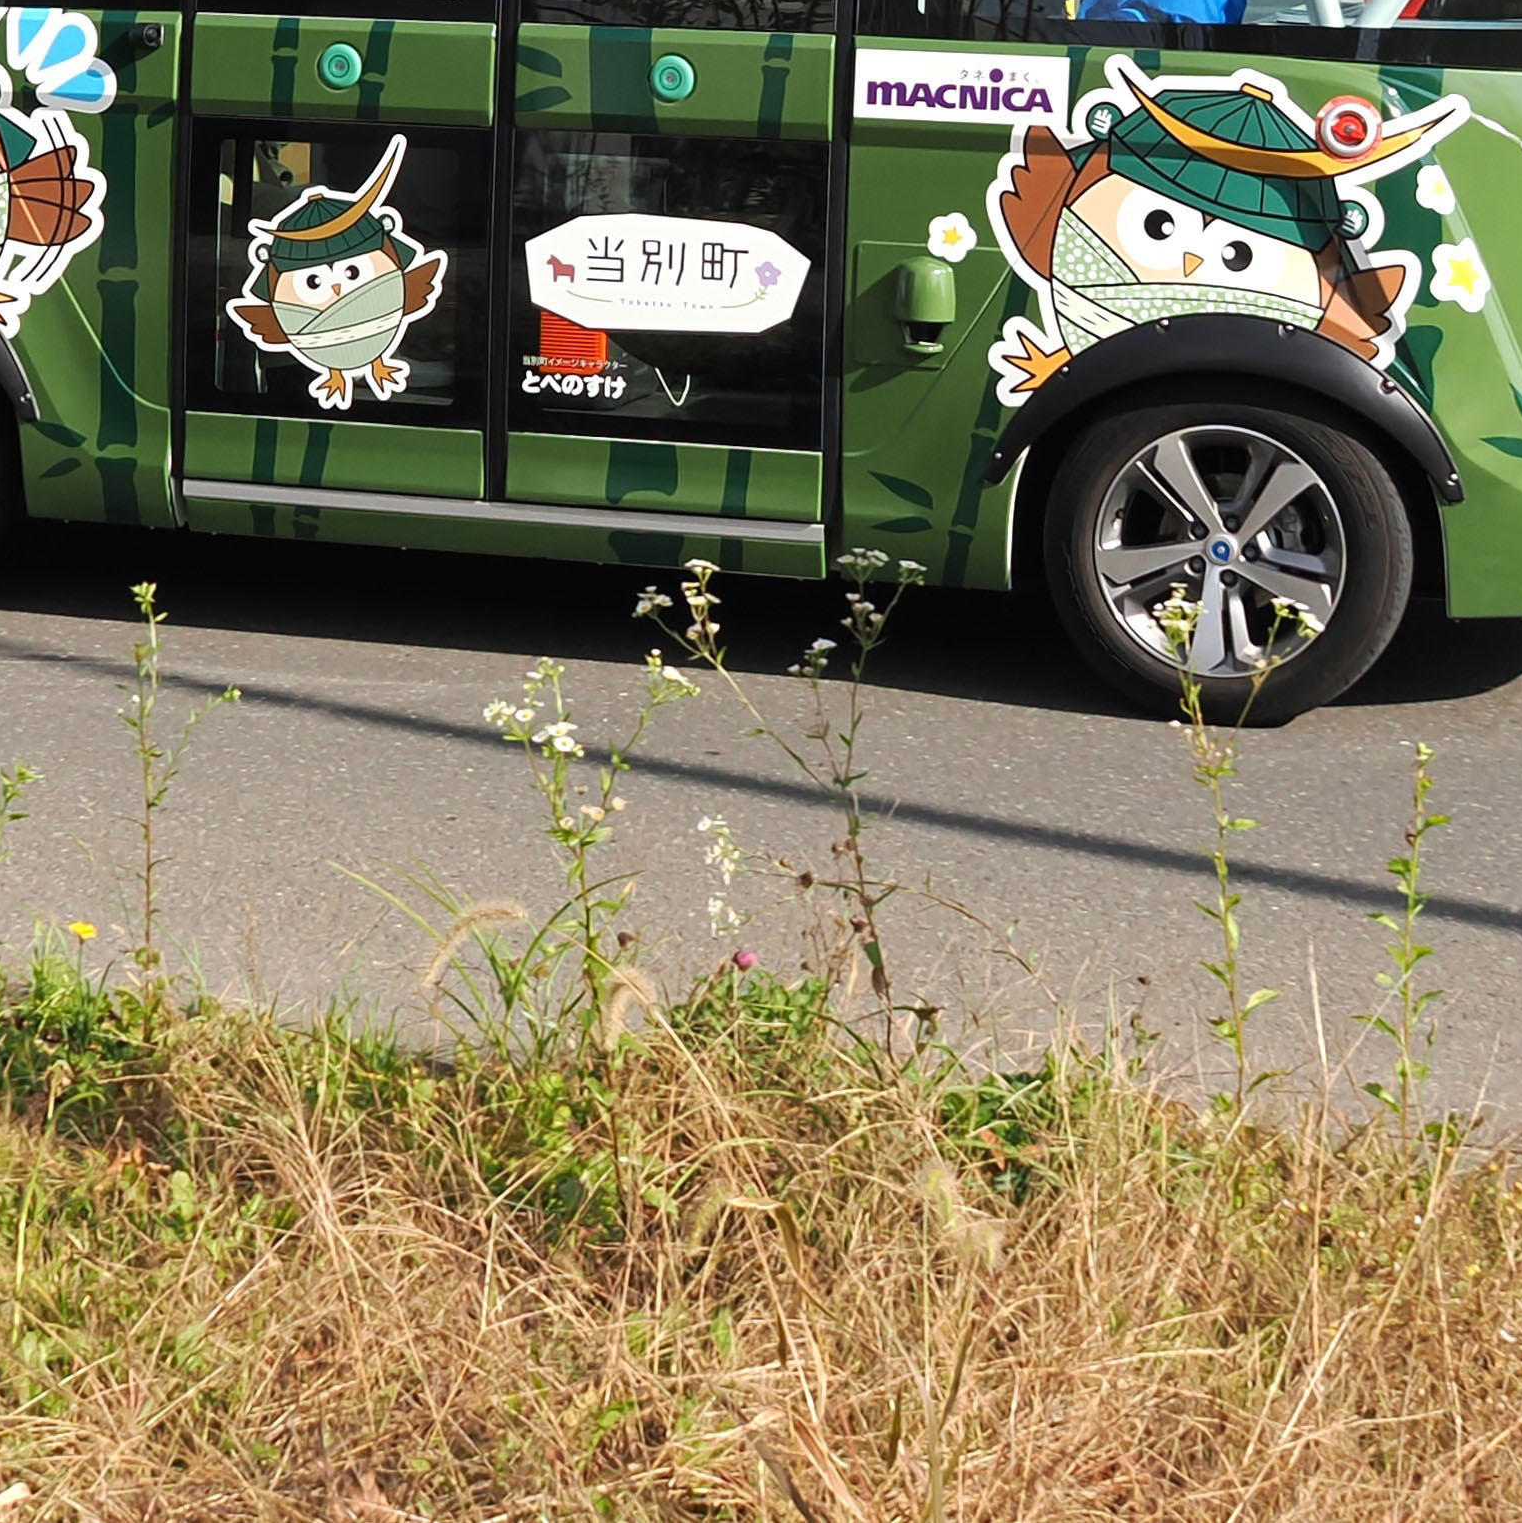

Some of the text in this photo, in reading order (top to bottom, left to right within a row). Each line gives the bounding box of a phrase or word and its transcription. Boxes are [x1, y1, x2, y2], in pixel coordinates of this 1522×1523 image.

[586, 236, 750, 289] 当別町
[521, 369, 628, 399] とべのすけ
